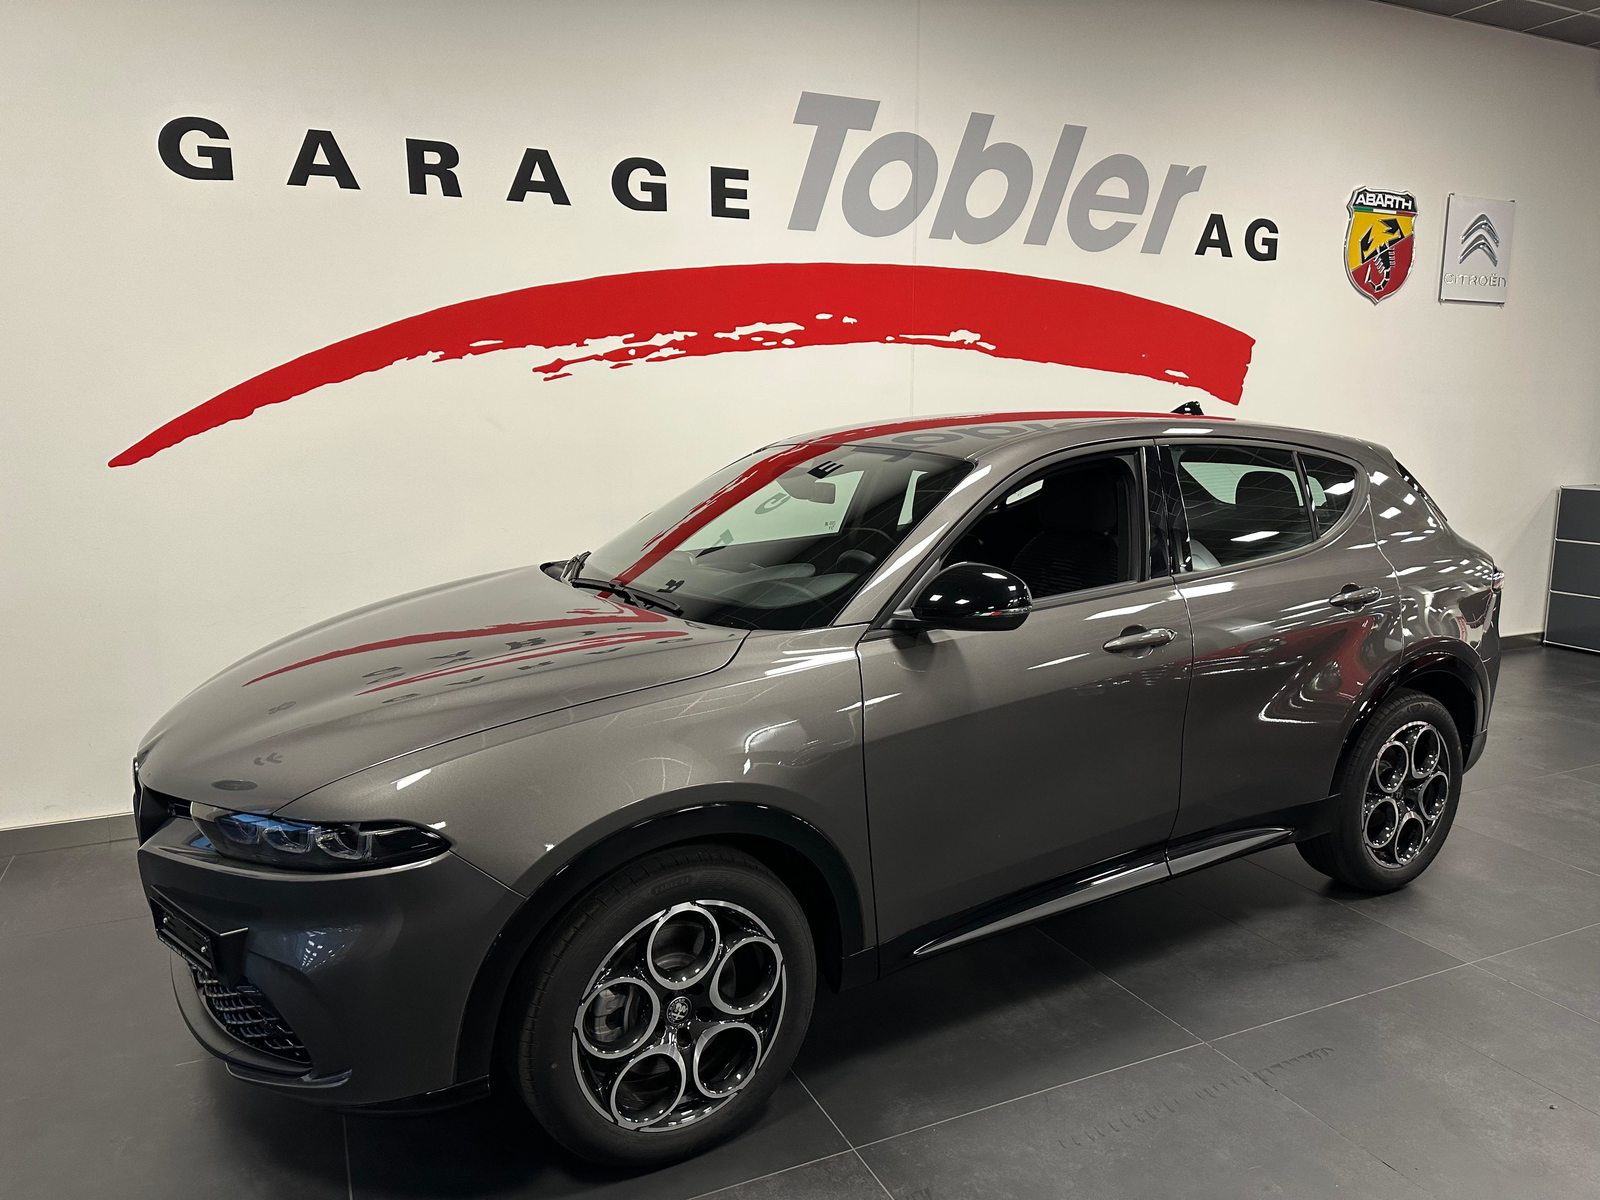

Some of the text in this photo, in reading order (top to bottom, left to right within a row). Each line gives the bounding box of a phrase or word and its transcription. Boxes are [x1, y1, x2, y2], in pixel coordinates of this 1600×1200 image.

[157, 91, 1279, 262] GARAGE Tobler AG
[1354, 193, 1412, 211] ABARTH
